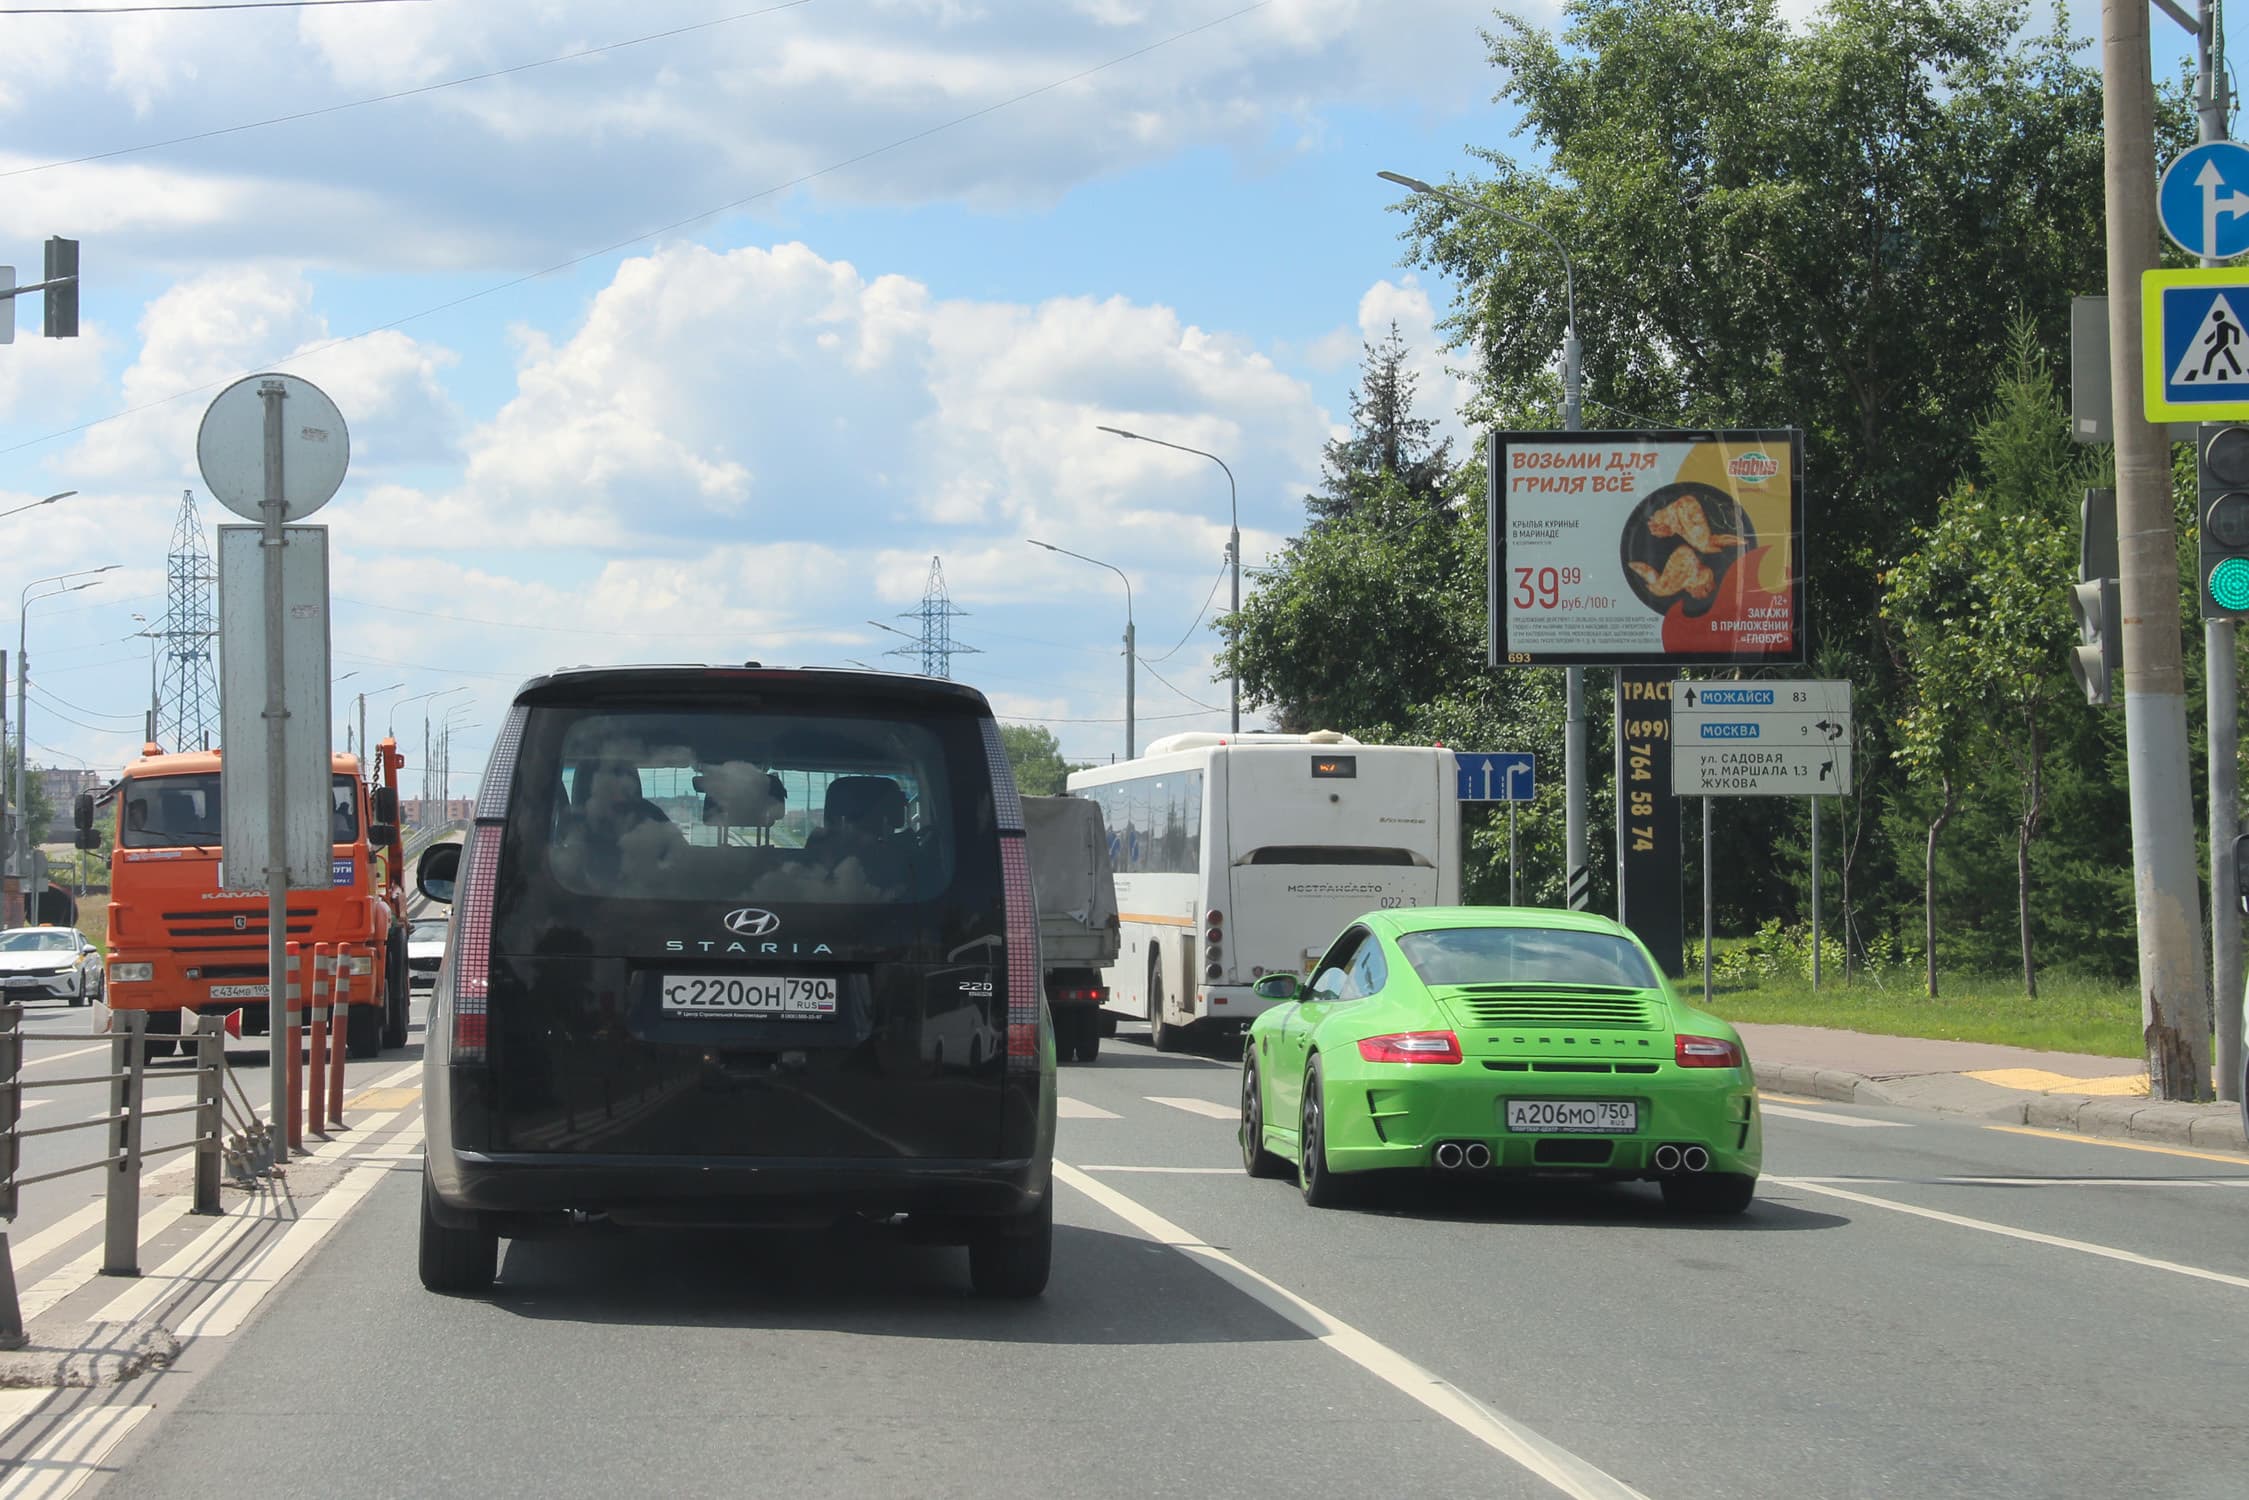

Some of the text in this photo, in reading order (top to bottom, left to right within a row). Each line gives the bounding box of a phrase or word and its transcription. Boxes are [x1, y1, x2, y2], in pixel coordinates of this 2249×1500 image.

[1512, 452, 1659, 471] ВОЗЬМИ ДЛЯ
[1512, 472, 1635, 494] ГРИЛЯ ВСЁ
[1512, 520, 1580, 529] КРЫЛЬЯ КУРИНЫЕ
[1512, 529, 1560, 538] В МАРИНАДЕ
[1562, 567, 1581, 585] 99
[1513, 567, 1559, 609] 39
[1562, 597, 1608, 611] руб./100
[1748, 608, 1789, 618] ЗАКАЖИ
[1711, 621, 1789, 631] В ПРИЛОЖЕНИИ
[1741, 633, 1789, 643] «ГЛОБУС»
[1508, 653, 1531, 663] 693
[1703, 689, 1807, 703] МОЖАЙСК 83
[1624, 719, 1669, 741] (499)
[1703, 726, 1808, 736] МОСКВА 9
[1701, 754, 1783, 764] ул. САДОВАЯ
[1701, 768, 1717, 777] ул.
[1721, 766, 1788, 776] МАРШАЛА
[1701, 778, 1757, 788] ЖУКОВА
[1630, 744, 1653, 851] 764 58 74
[666, 941, 832, 954] STARIA
[671, 980, 829, 1006] С220ОН 790
[1488, 1037, 1649, 1046] PORSCHE
[1515, 1104, 1629, 1124] А206МО 750
